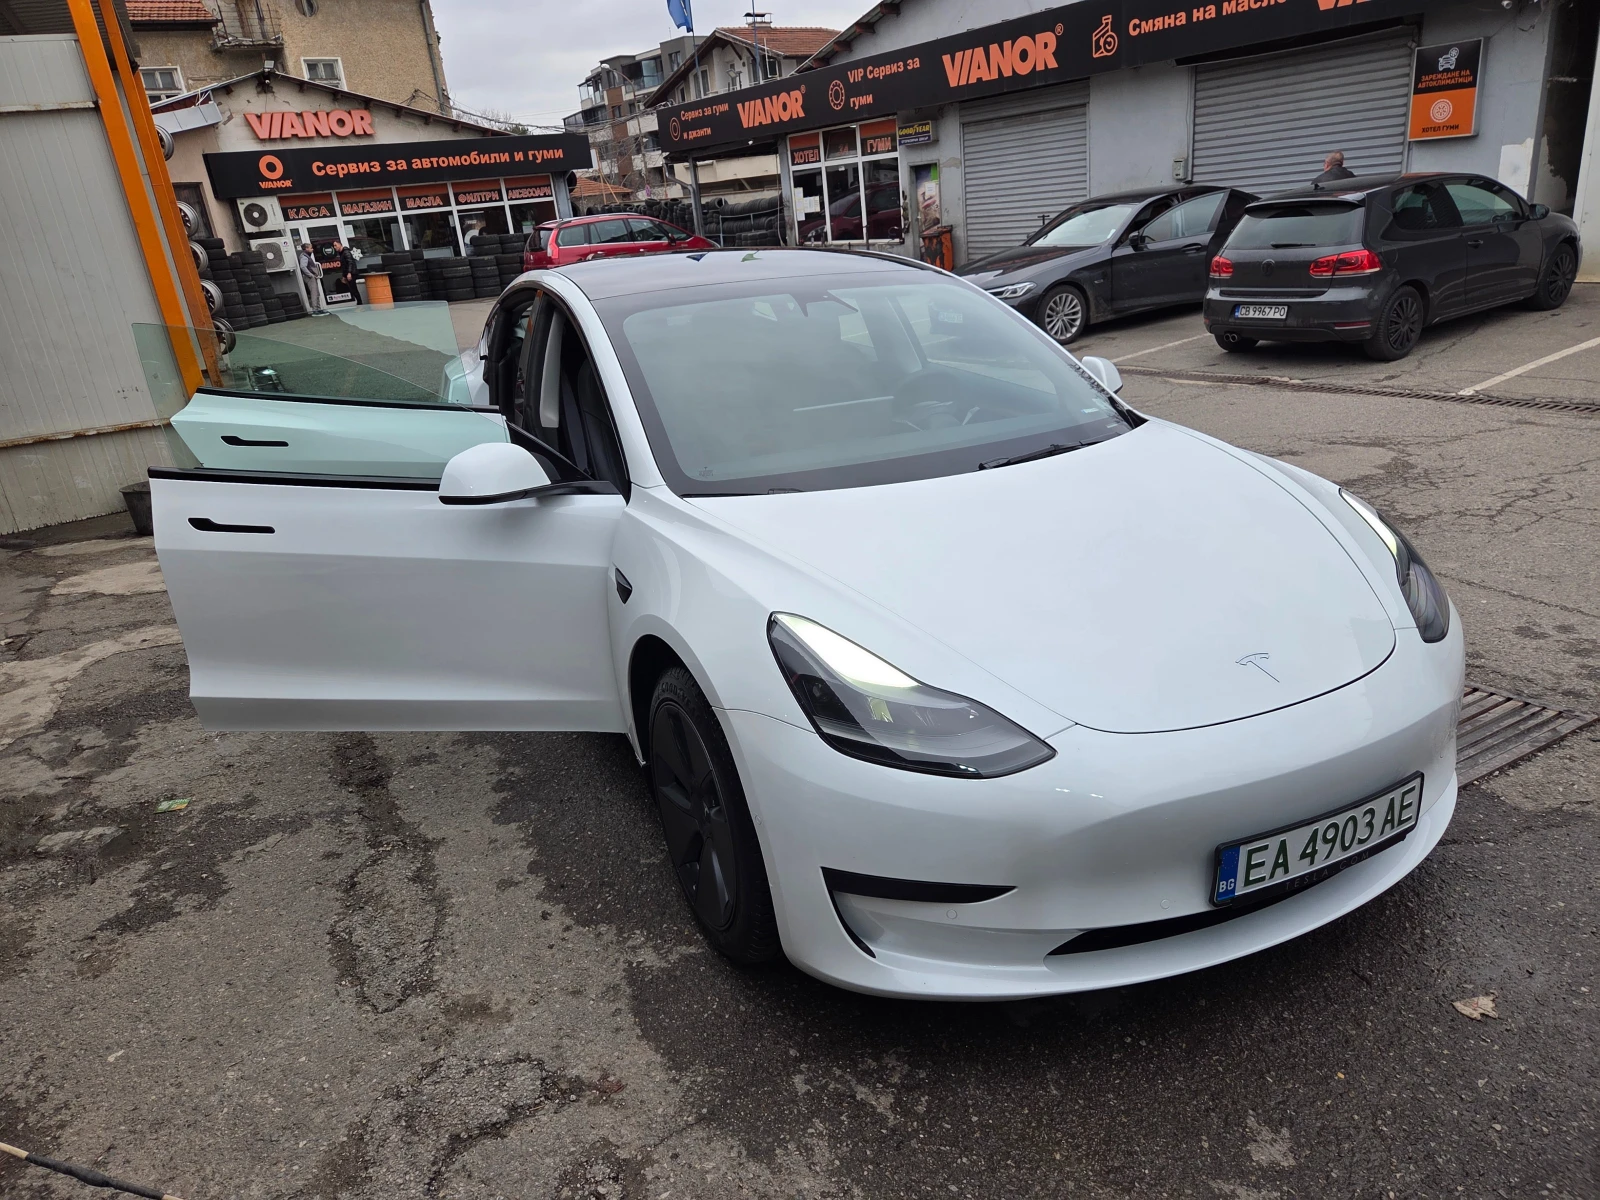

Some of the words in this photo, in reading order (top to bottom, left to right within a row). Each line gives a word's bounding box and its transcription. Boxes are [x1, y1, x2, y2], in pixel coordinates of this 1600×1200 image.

[1128, 11, 1187, 37] Смяна
[1192, 4, 1216, 23] на
[847, 68, 864, 83] VIP
[866, 61, 904, 80] Сервиз
[906, 57, 920, 70] за
[1421, 71, 1460, 81] ЗАРЕЖДАНЕ
[1417, 75, 1473, 88] АВТОКЛИМАТИЦИ
[850, 94, 873, 110] гуми
[680, 109, 703, 121] Сервиз
[704, 106, 712, 116] за
[713, 103, 729, 116] гуми
[243, 109, 376, 140] VIANOR
[898, 124, 930, 136] GOODYEAR
[1421, 125, 1440, 133] ХОТЕЛ
[683, 131, 688, 139] и
[688, 127, 712, 140] джанти
[793, 149, 820, 164] ХОТЕЛ
[866, 136, 892, 153] ГУМИ
[312, 161, 381, 178] Сервиз
[386, 159, 408, 171] за
[412, 151, 510, 169] автомобили
[514, 150, 524, 161] и
[528, 148, 563, 164] гуми
[259, 179, 293, 189] VIANOR
[406, 195, 443, 208] МАСЛА
[458, 191, 499, 203] ФИЛТРИ
[288, 206, 330, 219] КАСА
[342, 201, 392, 214] МАГАЗИН
[1240, 306, 1250, 316] CB
[1252, 306, 1273, 316] 9967
[1273, 306, 1286, 317] PO
[1243, 838, 1290, 887] EA
[1298, 806, 1376, 867] 4903
[1379, 785, 1417, 837] AE
[1218, 878, 1236, 893] BG
